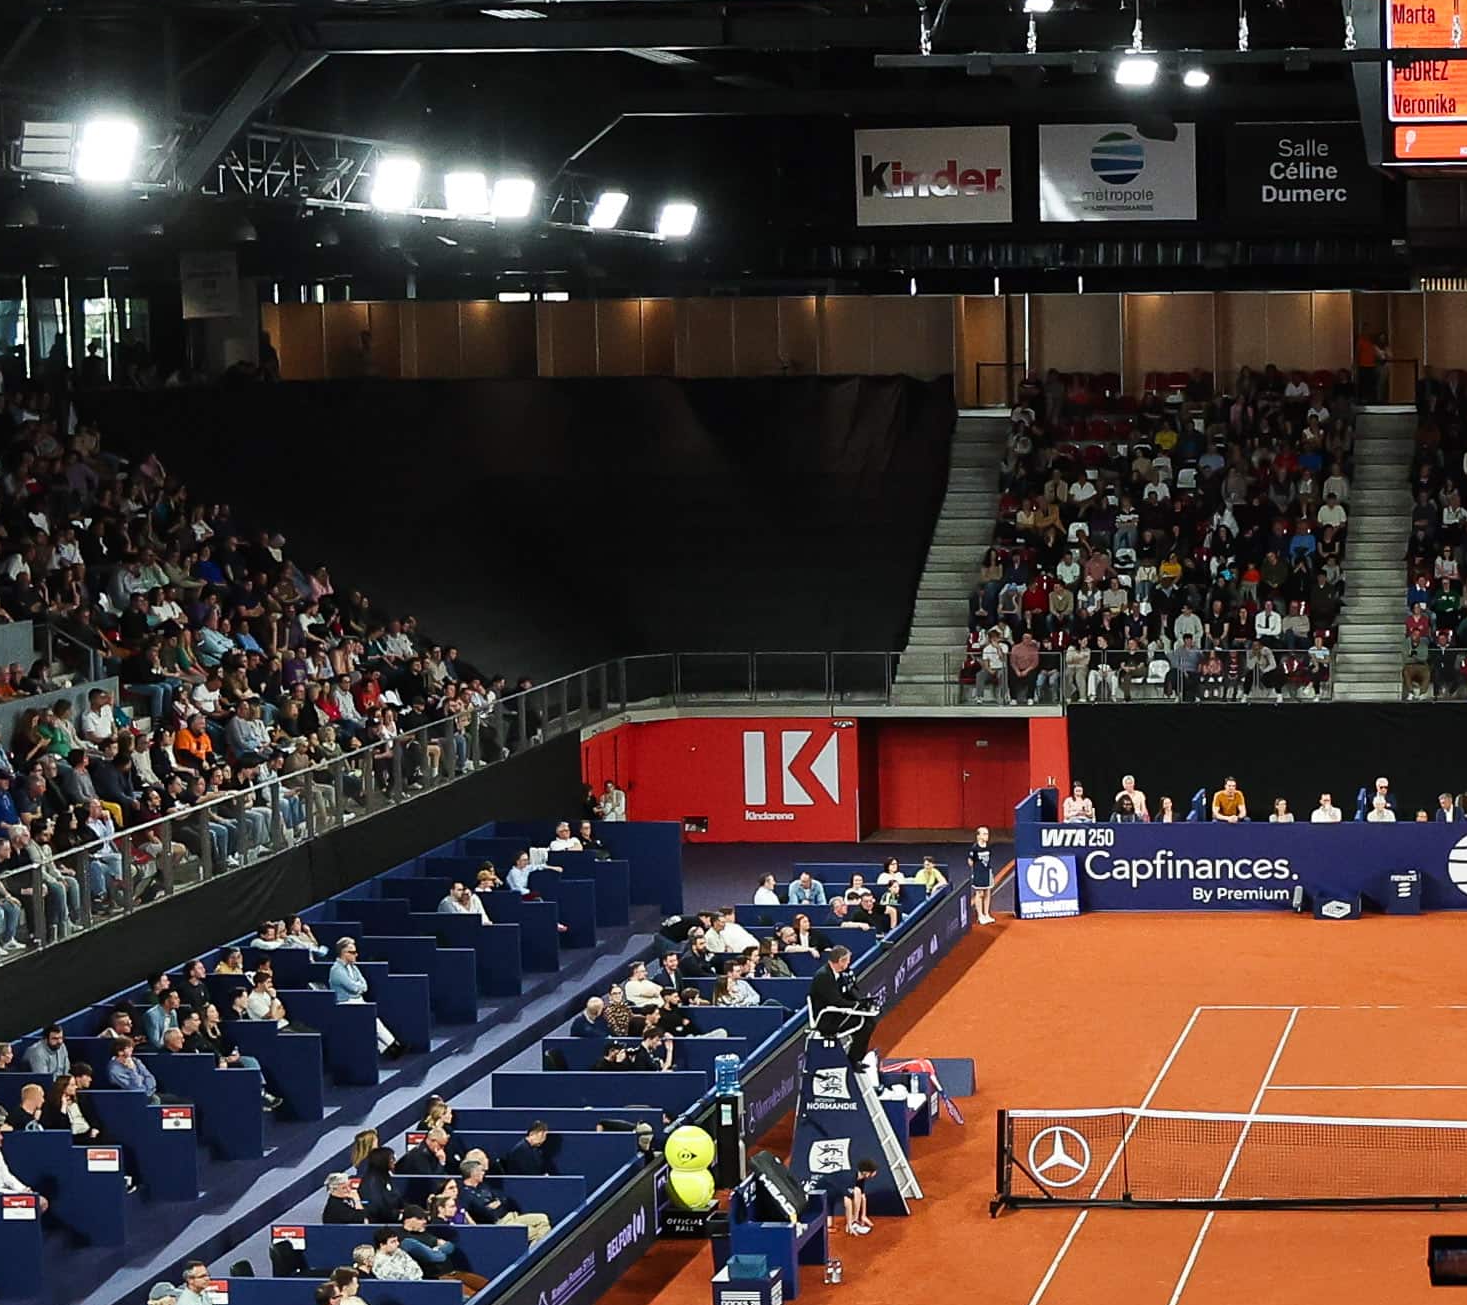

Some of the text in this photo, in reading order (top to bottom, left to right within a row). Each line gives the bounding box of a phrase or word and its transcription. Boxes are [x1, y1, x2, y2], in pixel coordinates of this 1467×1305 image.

[1393, 4, 1435, 25] Marta
[1394, 92, 1456, 115] Veronika
[1278, 138, 1330, 157] Salle
[1269, 160, 1338, 180] Céline
[1261, 183, 1347, 203] Dumerc
[744, 809, 795, 821] Kindarena
[1041, 828, 1114, 846] WTA 250
[1033, 861, 1059, 894] 76
[1085, 849, 1299, 888] Capfinances.
[1192, 887, 1289, 902] By Premium
[806, 1101, 858, 1111] NORMANDIE
